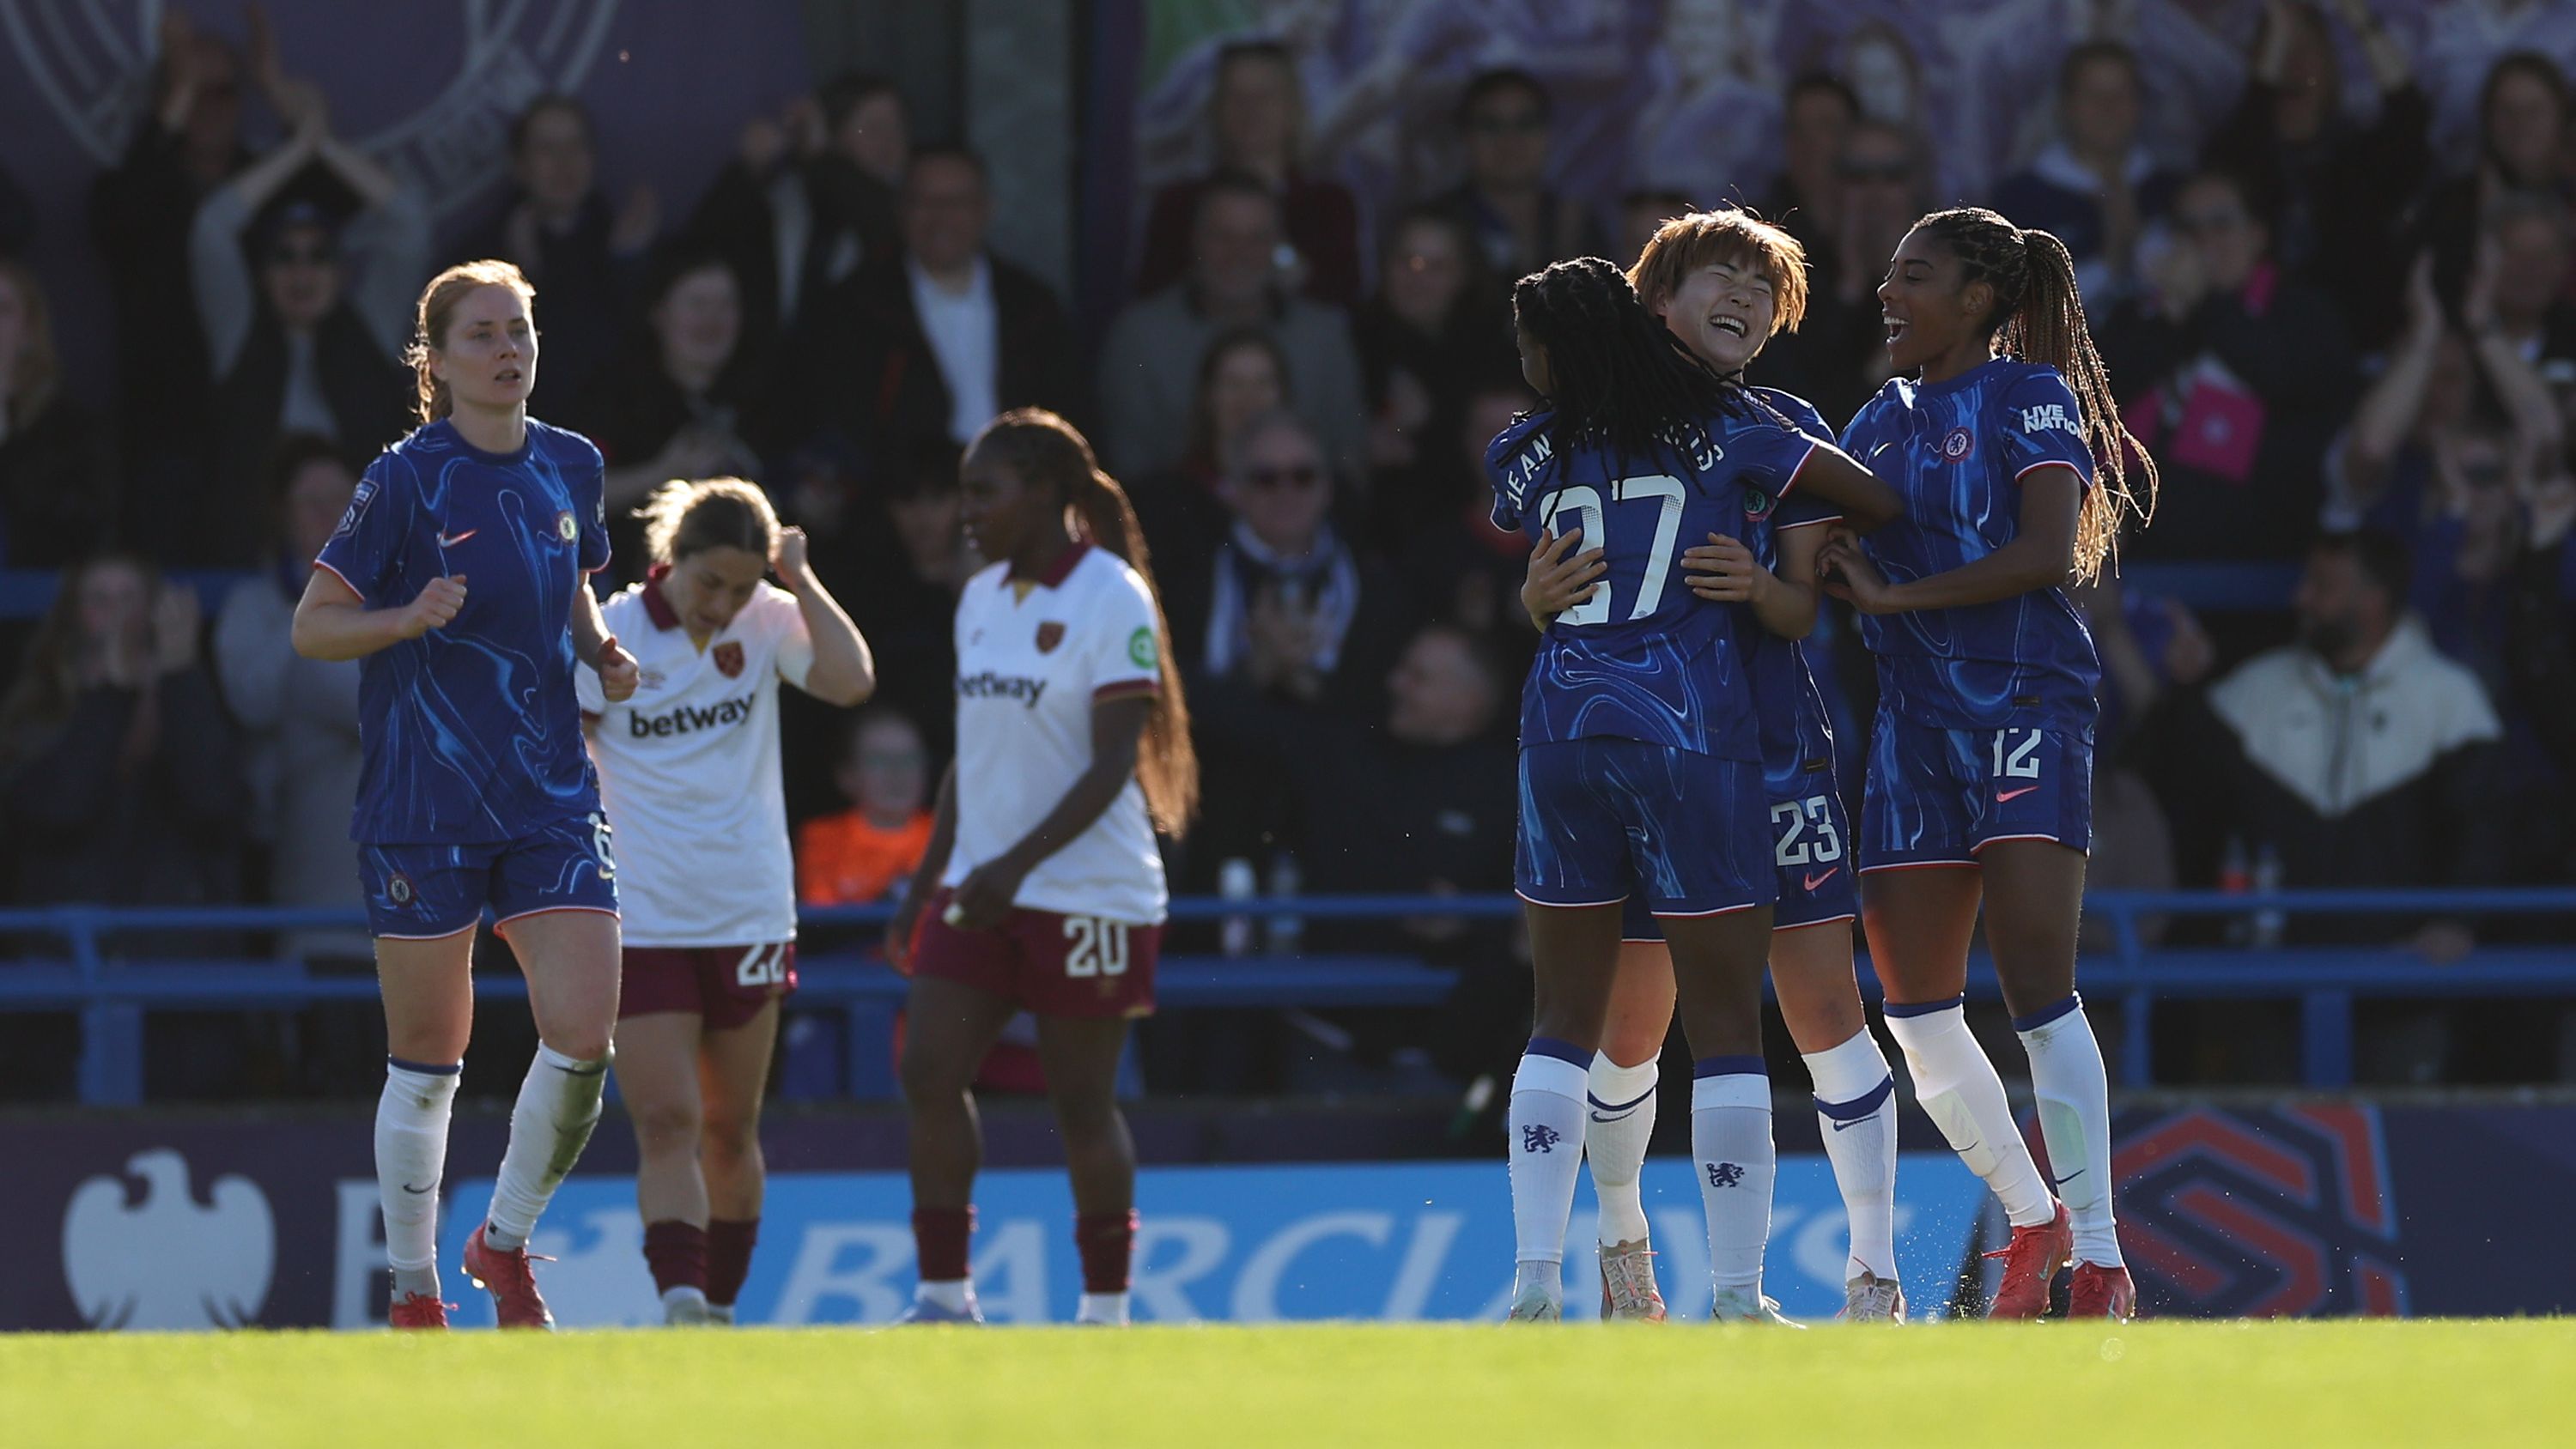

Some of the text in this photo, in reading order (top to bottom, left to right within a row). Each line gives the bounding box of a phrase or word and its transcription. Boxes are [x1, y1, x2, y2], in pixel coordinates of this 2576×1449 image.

[2022, 404, 2064, 420] LIVE
[1540, 474, 1686, 626] 27
[630, 692, 755, 738] betway
[1993, 728, 2042, 779] 12
[1771, 795, 1841, 866] 23
[1063, 917, 1128, 977] 20
